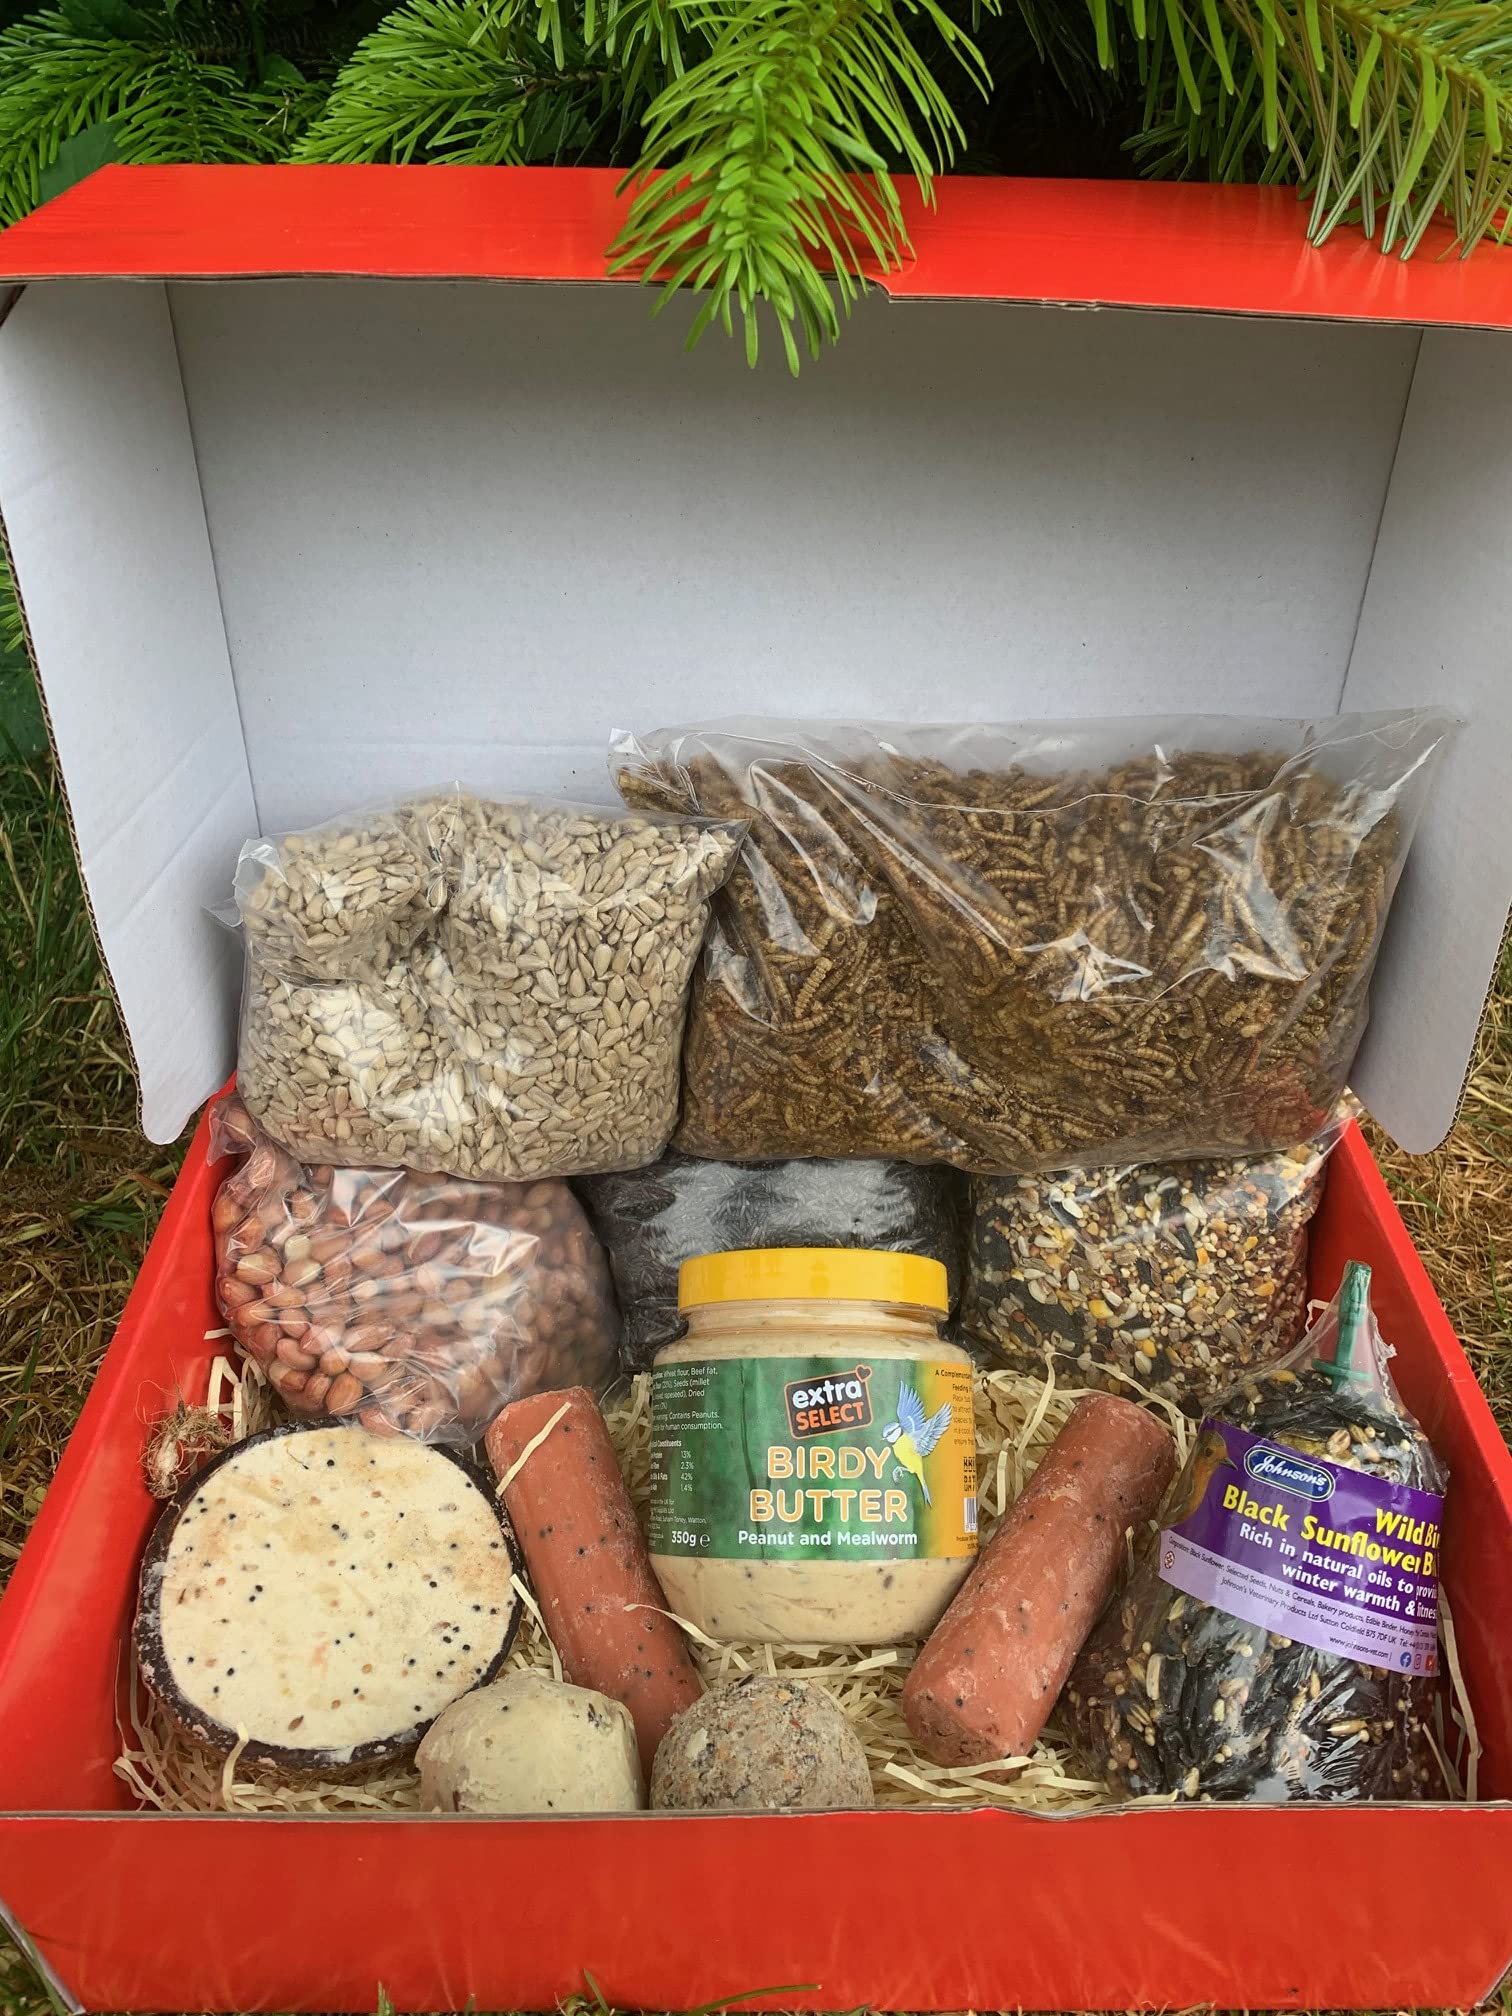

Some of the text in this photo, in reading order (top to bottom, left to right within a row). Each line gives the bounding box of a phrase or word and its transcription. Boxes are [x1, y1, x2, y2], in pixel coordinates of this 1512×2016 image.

[691, 1367, 705, 1375] Beef
[792, 1380, 862, 1408] extra
[953, 1384, 968, 1393] Feeding
[681, 1421, 723, 1431] consumption.
[796, 1402, 864, 1430] SELECT
[767, 1446, 892, 1479] BIRDY
[1252, 1455, 1327, 1486] Johnson's
[750, 1490, 908, 1522] BUTTER
[1222, 1484, 1290, 1532] Black
[672, 1531, 696, 1546] 350g
[738, 1530, 918, 1546] Peanut and Mealworm
[1376, 1508, 1425, 1545] Wild
[1239, 1523, 1273, 1548] Rich
[1279, 1538, 1296, 1557] in
[1302, 1550, 1364, 1580] natural
[1368, 1567, 1392, 1588] oils
[1397, 1579, 1414, 1594] to
[1226, 1565, 1249, 1581] Selected
[1269, 1583, 1284, 1595] Nuts
[1318, 1601, 1338, 1615] Bakery
[1366, 1616, 1380, 1626] Edible
[1282, 1564, 1338, 1593] winter
[1344, 1586, 1400, 1612] warmth
[1405, 1600, 1416, 1617] &
[1220, 1577, 1247, 1594] Johnson's
[1249, 1588, 1280, 1608] Veterinary
[1280, 1601, 1306, 1617] Products
[1308, 1611, 1318, 1620] Ltd
[1319, 1615, 1339, 1628] Sutton
[1366, 1629, 1376, 1638] B75
[1388, 1636, 1397, 1644] UK
